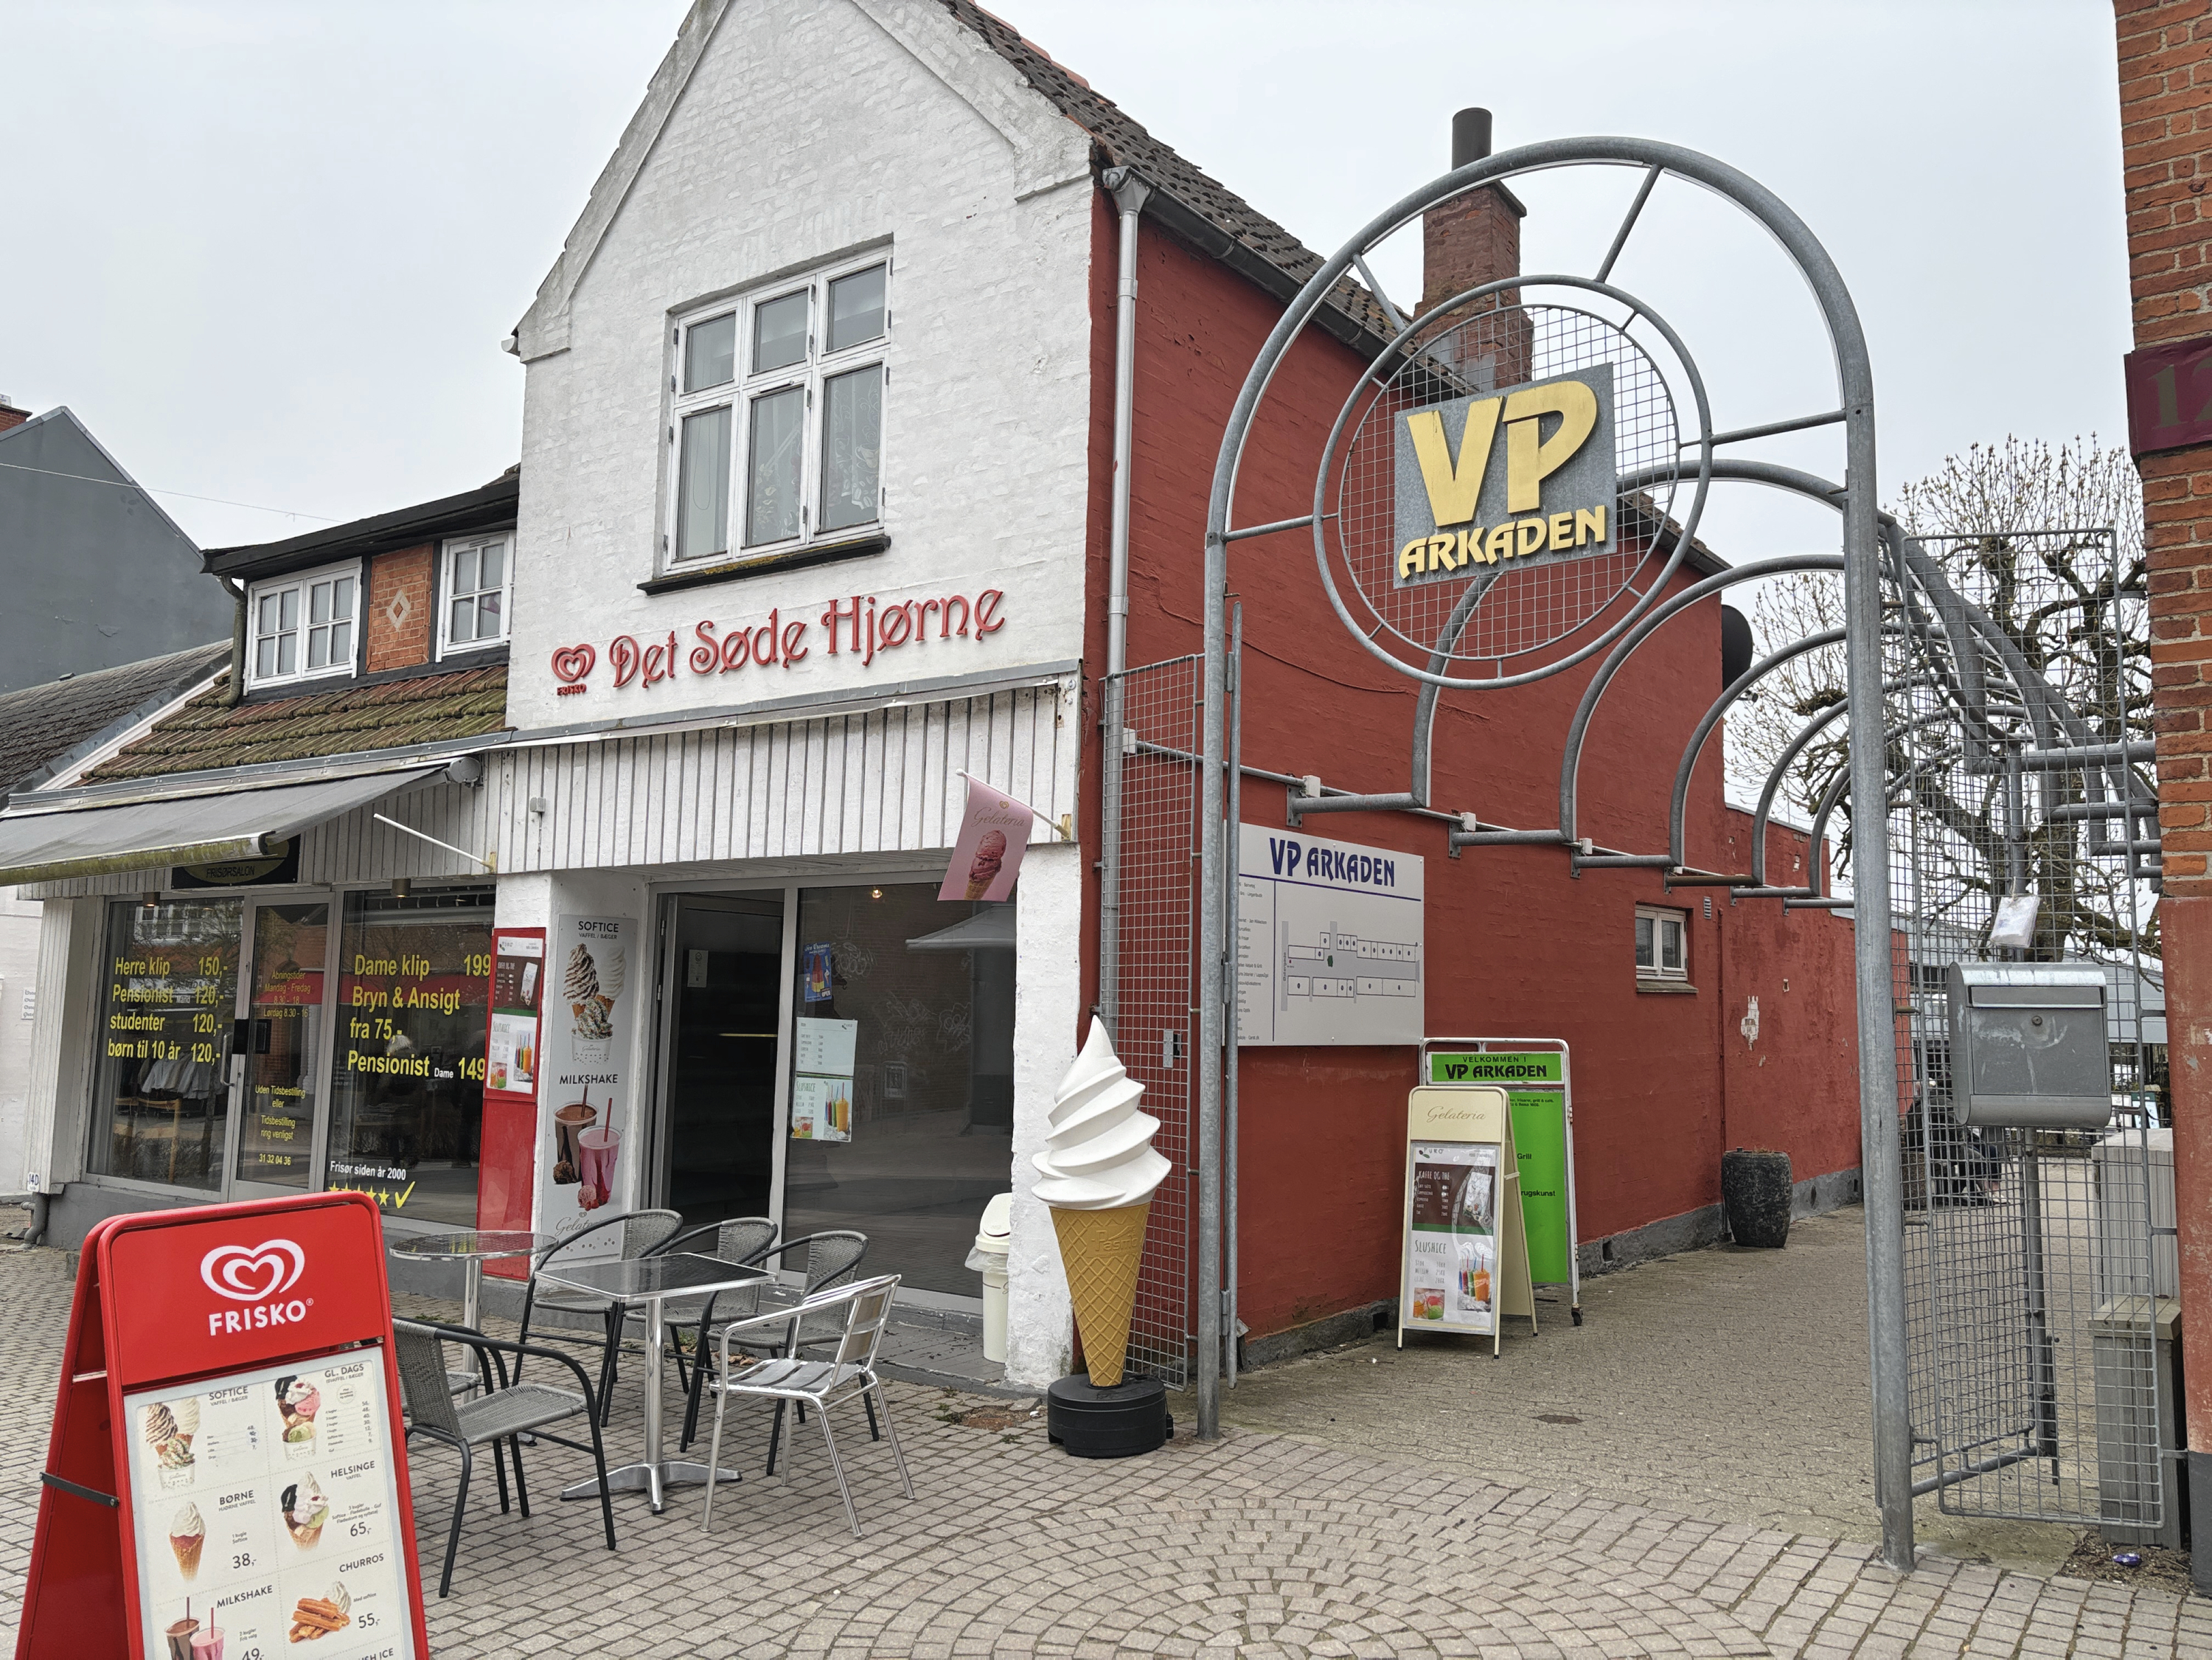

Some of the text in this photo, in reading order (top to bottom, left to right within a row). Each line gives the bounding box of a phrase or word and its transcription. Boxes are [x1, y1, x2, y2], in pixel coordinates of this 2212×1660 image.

[1407, 381, 1597, 527] VP
[1399, 505, 1607, 580] ARKADEN
[609, 589, 1005, 689] Det Søde Hjørne
[557, 683, 588, 695] FRISKO
[970, 806, 1026, 827] Gelateria
[1270, 837, 1395, 887] VP ARKADEN
[206, 866, 255, 878] FRISØRSALON
[578, 921, 619, 932] SOFTICE
[115, 956, 228, 979] Herre klip 150,-
[355, 954, 397, 976] Dame
[402, 954, 430, 981] klip
[112, 984, 173, 1003] Pensionist
[195, 986, 223, 1007] 120,-
[352, 986, 460, 1015] Bryn & Ansigt
[110, 1012, 222, 1037] studenter 120,-
[350, 1017, 402, 1044] fra 75,-
[108, 1038, 220, 1066] børn til 10 år 120,-
[348, 1050, 486, 1081] Pensionist Dame 149
[1445, 1064, 1547, 1079] VP ARKADEN
[560, 1074, 619, 1084] MILKSHAKE
[255, 1085, 269, 1094] Uden
[272, 1099, 285, 1108] eller
[1426, 1106, 1486, 1122] Gelateria
[259, 1153, 265, 1162] 31
[267, 1154, 274, 1164] 32
[330, 1160, 406, 1181] Frisør siden år 2000
[1521, 1190, 1556, 1198] rugskunst
[1414, 1240, 1446, 1254] SLUSHICE
[209, 1300, 306, 1336] FRISKO
[324, 1364, 364, 1378] GL. DAGS
[209, 1386, 248, 1400] SOFTICE
[331, 1460, 375, 1478] HELSINGE
[219, 1490, 254, 1505] BØRNE
[350, 1521, 372, 1537] 65,-
[232, 1552, 257, 1569] 38,-
[339, 1553, 384, 1572] CHURROS
[217, 1585, 273, 1608] MILKSHAKE
[358, 1612, 380, 1629] 55,-
